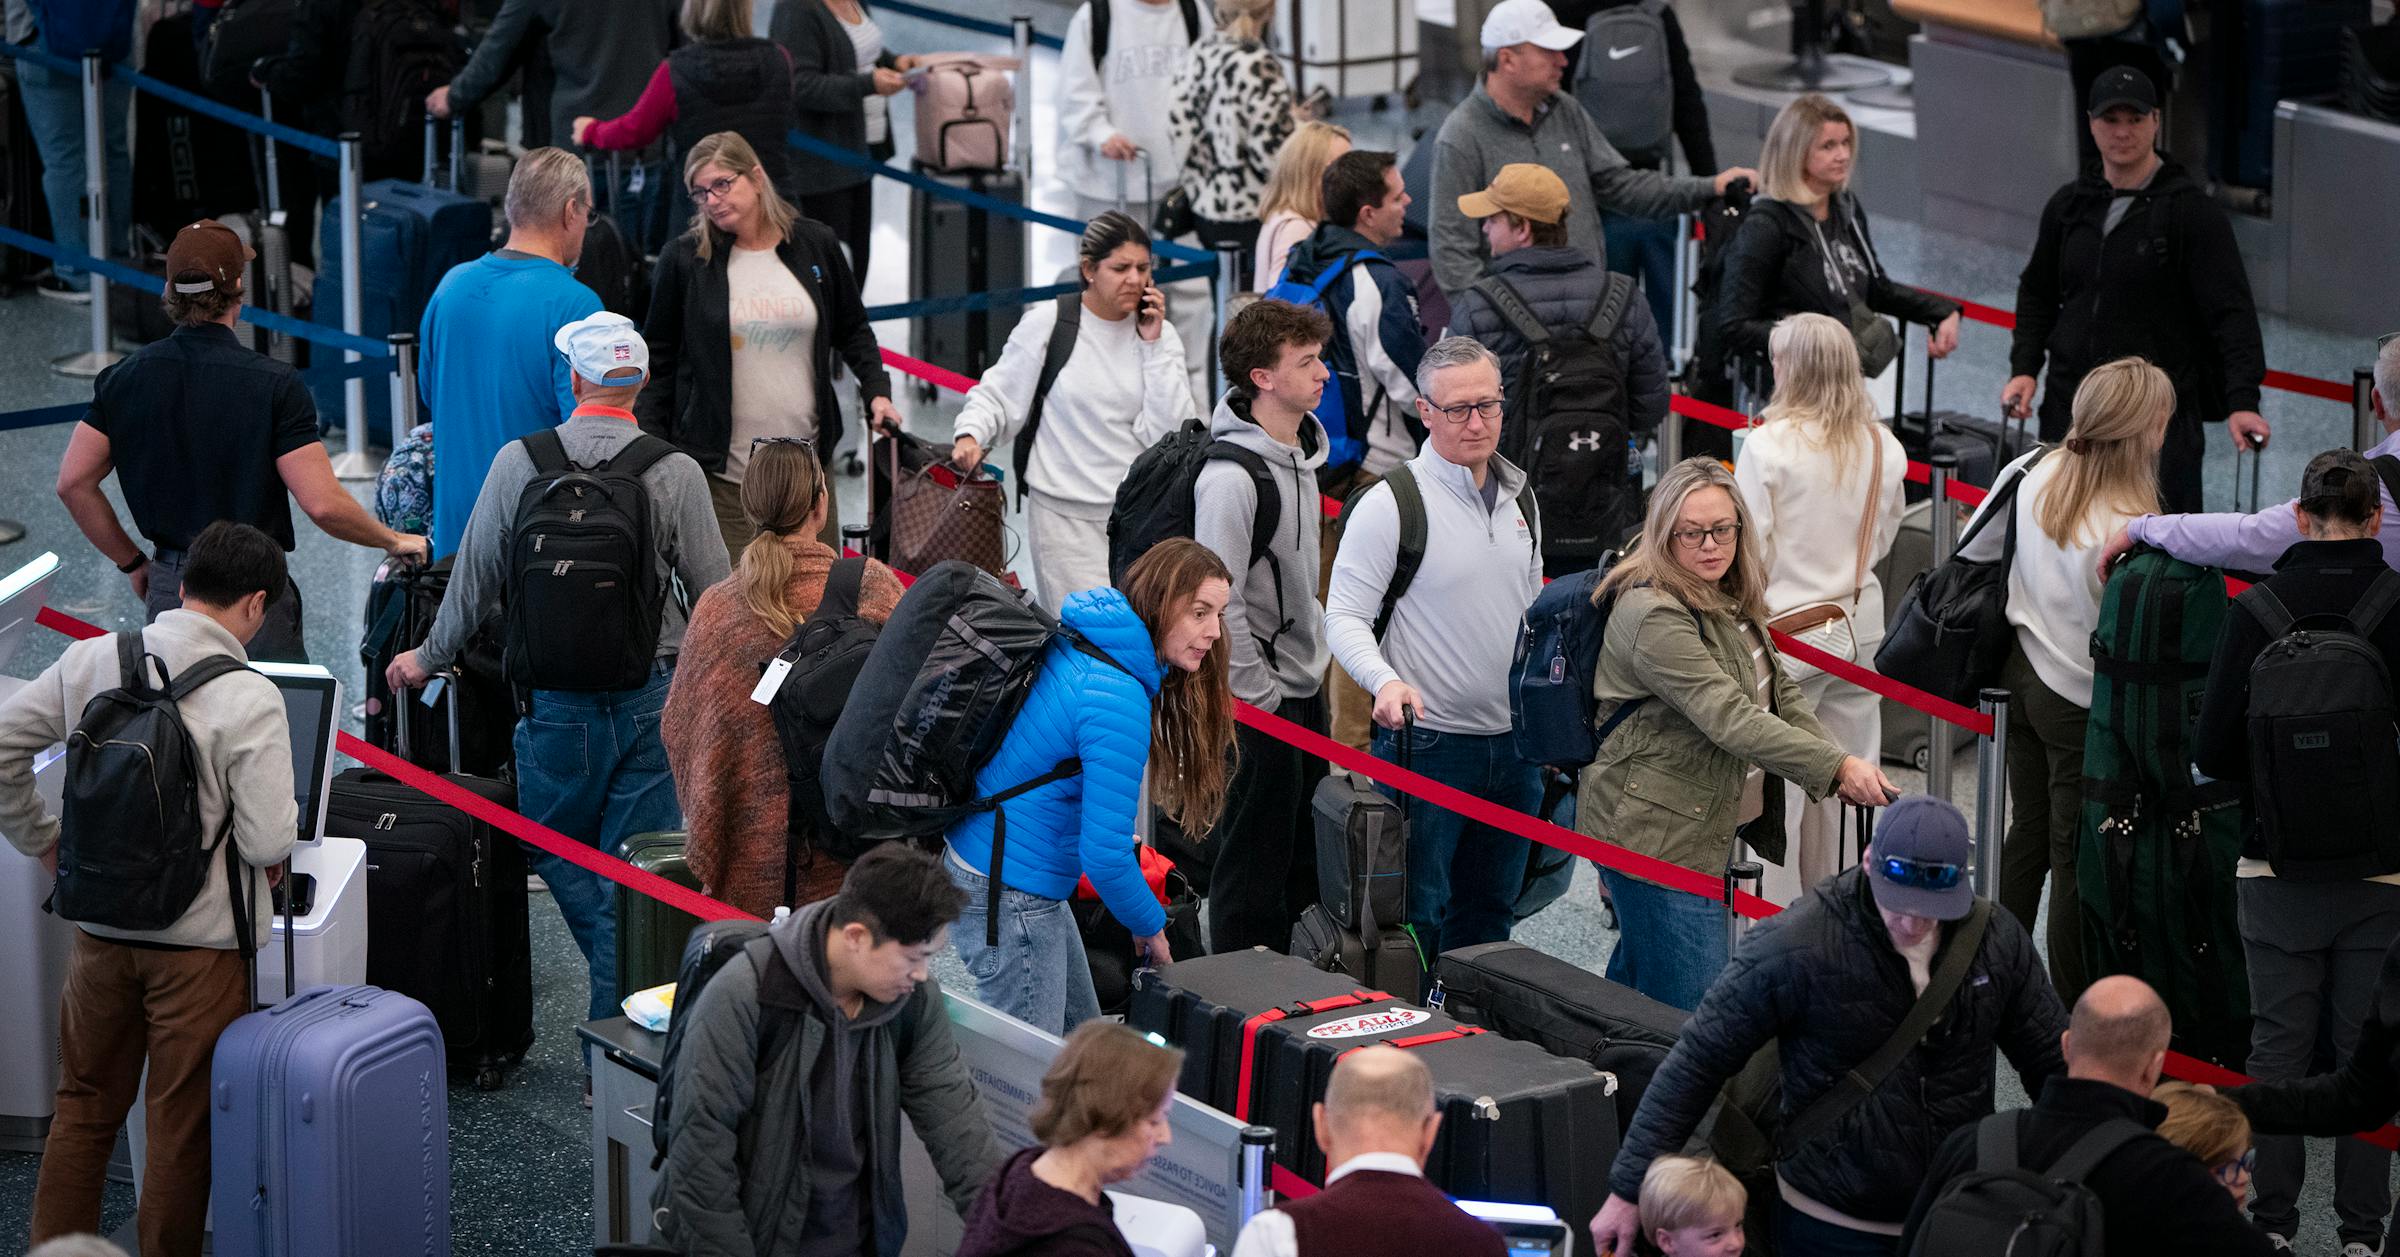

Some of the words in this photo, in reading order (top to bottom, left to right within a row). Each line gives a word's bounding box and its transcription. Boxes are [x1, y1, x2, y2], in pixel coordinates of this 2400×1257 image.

[731, 296, 804, 324] ANNED
[2297, 735, 2326, 745] YETI
[1312, 1023, 1356, 1037] TRI
[1358, 1015, 1400, 1030] ALL
[1399, 1011, 1416, 1021] 3
[1362, 1020, 1415, 1034] SPORTS
[2347, 1247, 2364, 1256] NIKE
